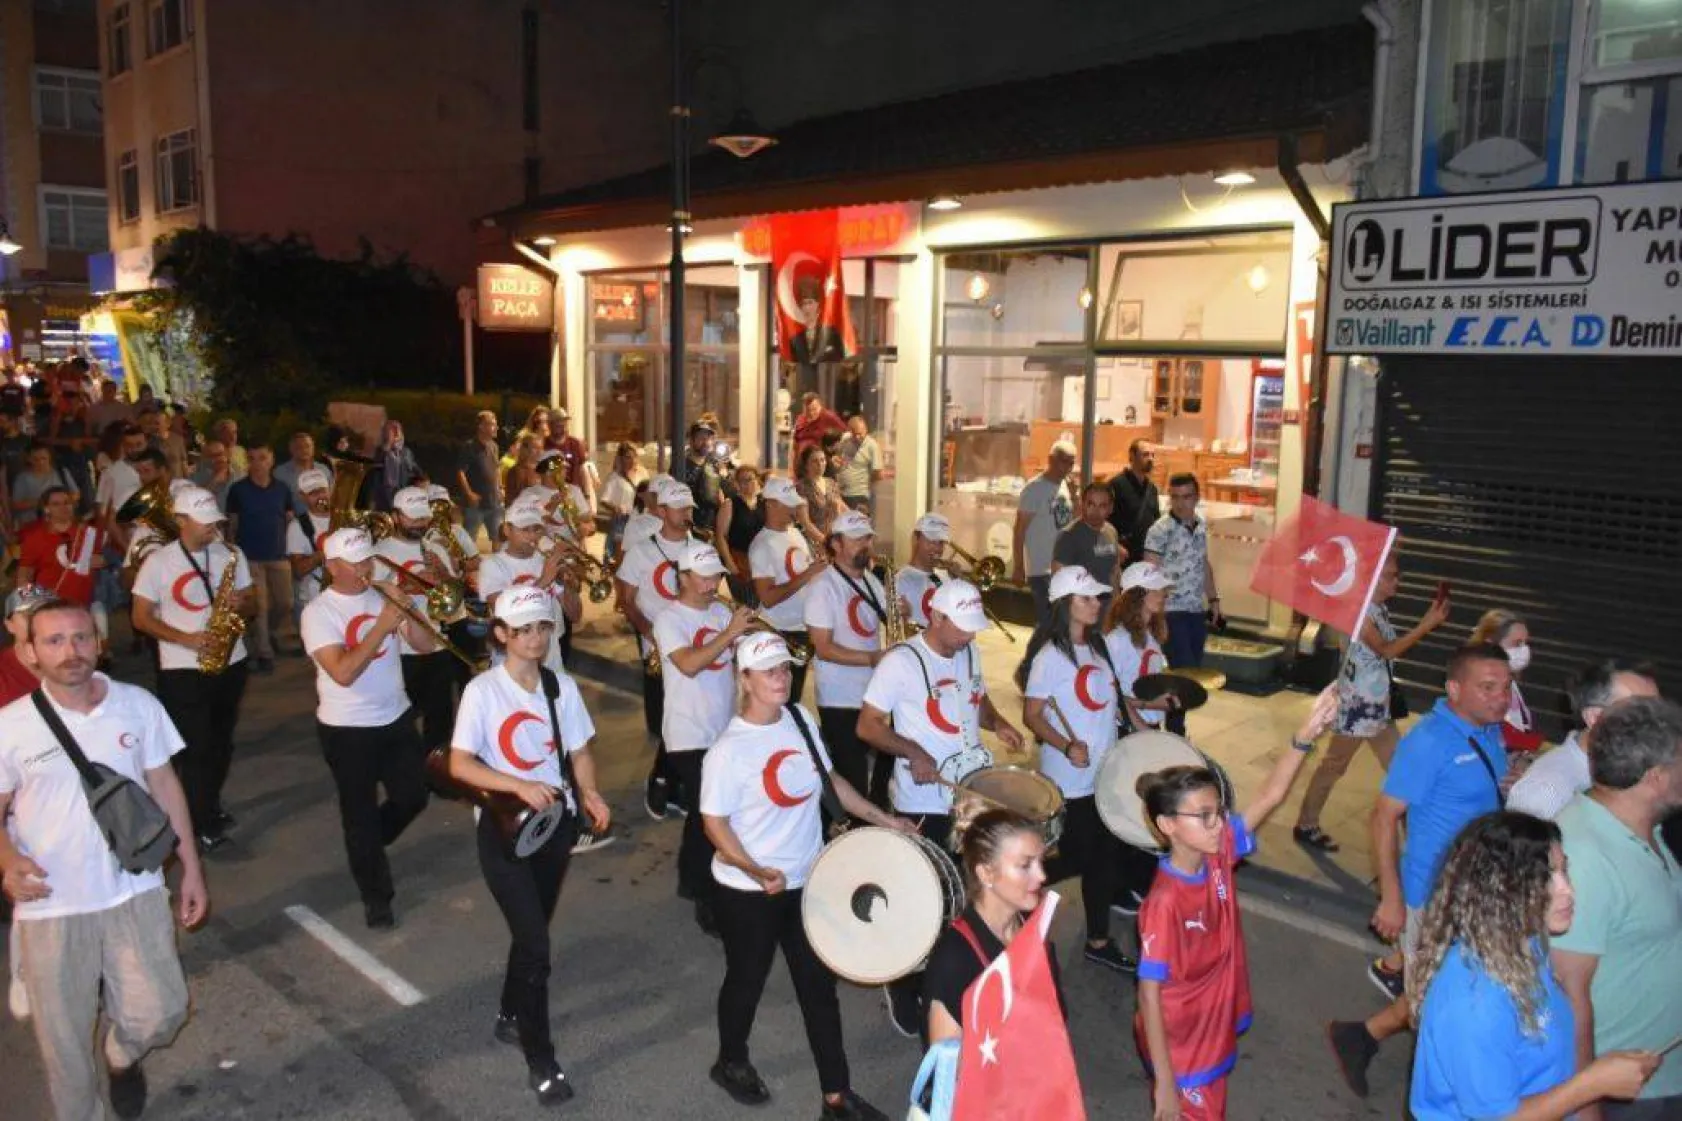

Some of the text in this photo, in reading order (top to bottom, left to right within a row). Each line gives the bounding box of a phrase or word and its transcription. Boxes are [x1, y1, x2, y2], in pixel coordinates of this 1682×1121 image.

[1391, 213, 1591, 281] LİDER
[1645, 239, 1682, 263] M
[491, 299, 540, 318] PAÇA
[1343, 287, 1588, 311] DOĞALGAZ & ISI SİSTEMLERİ
[1356, 317, 1437, 347] Vaillant
